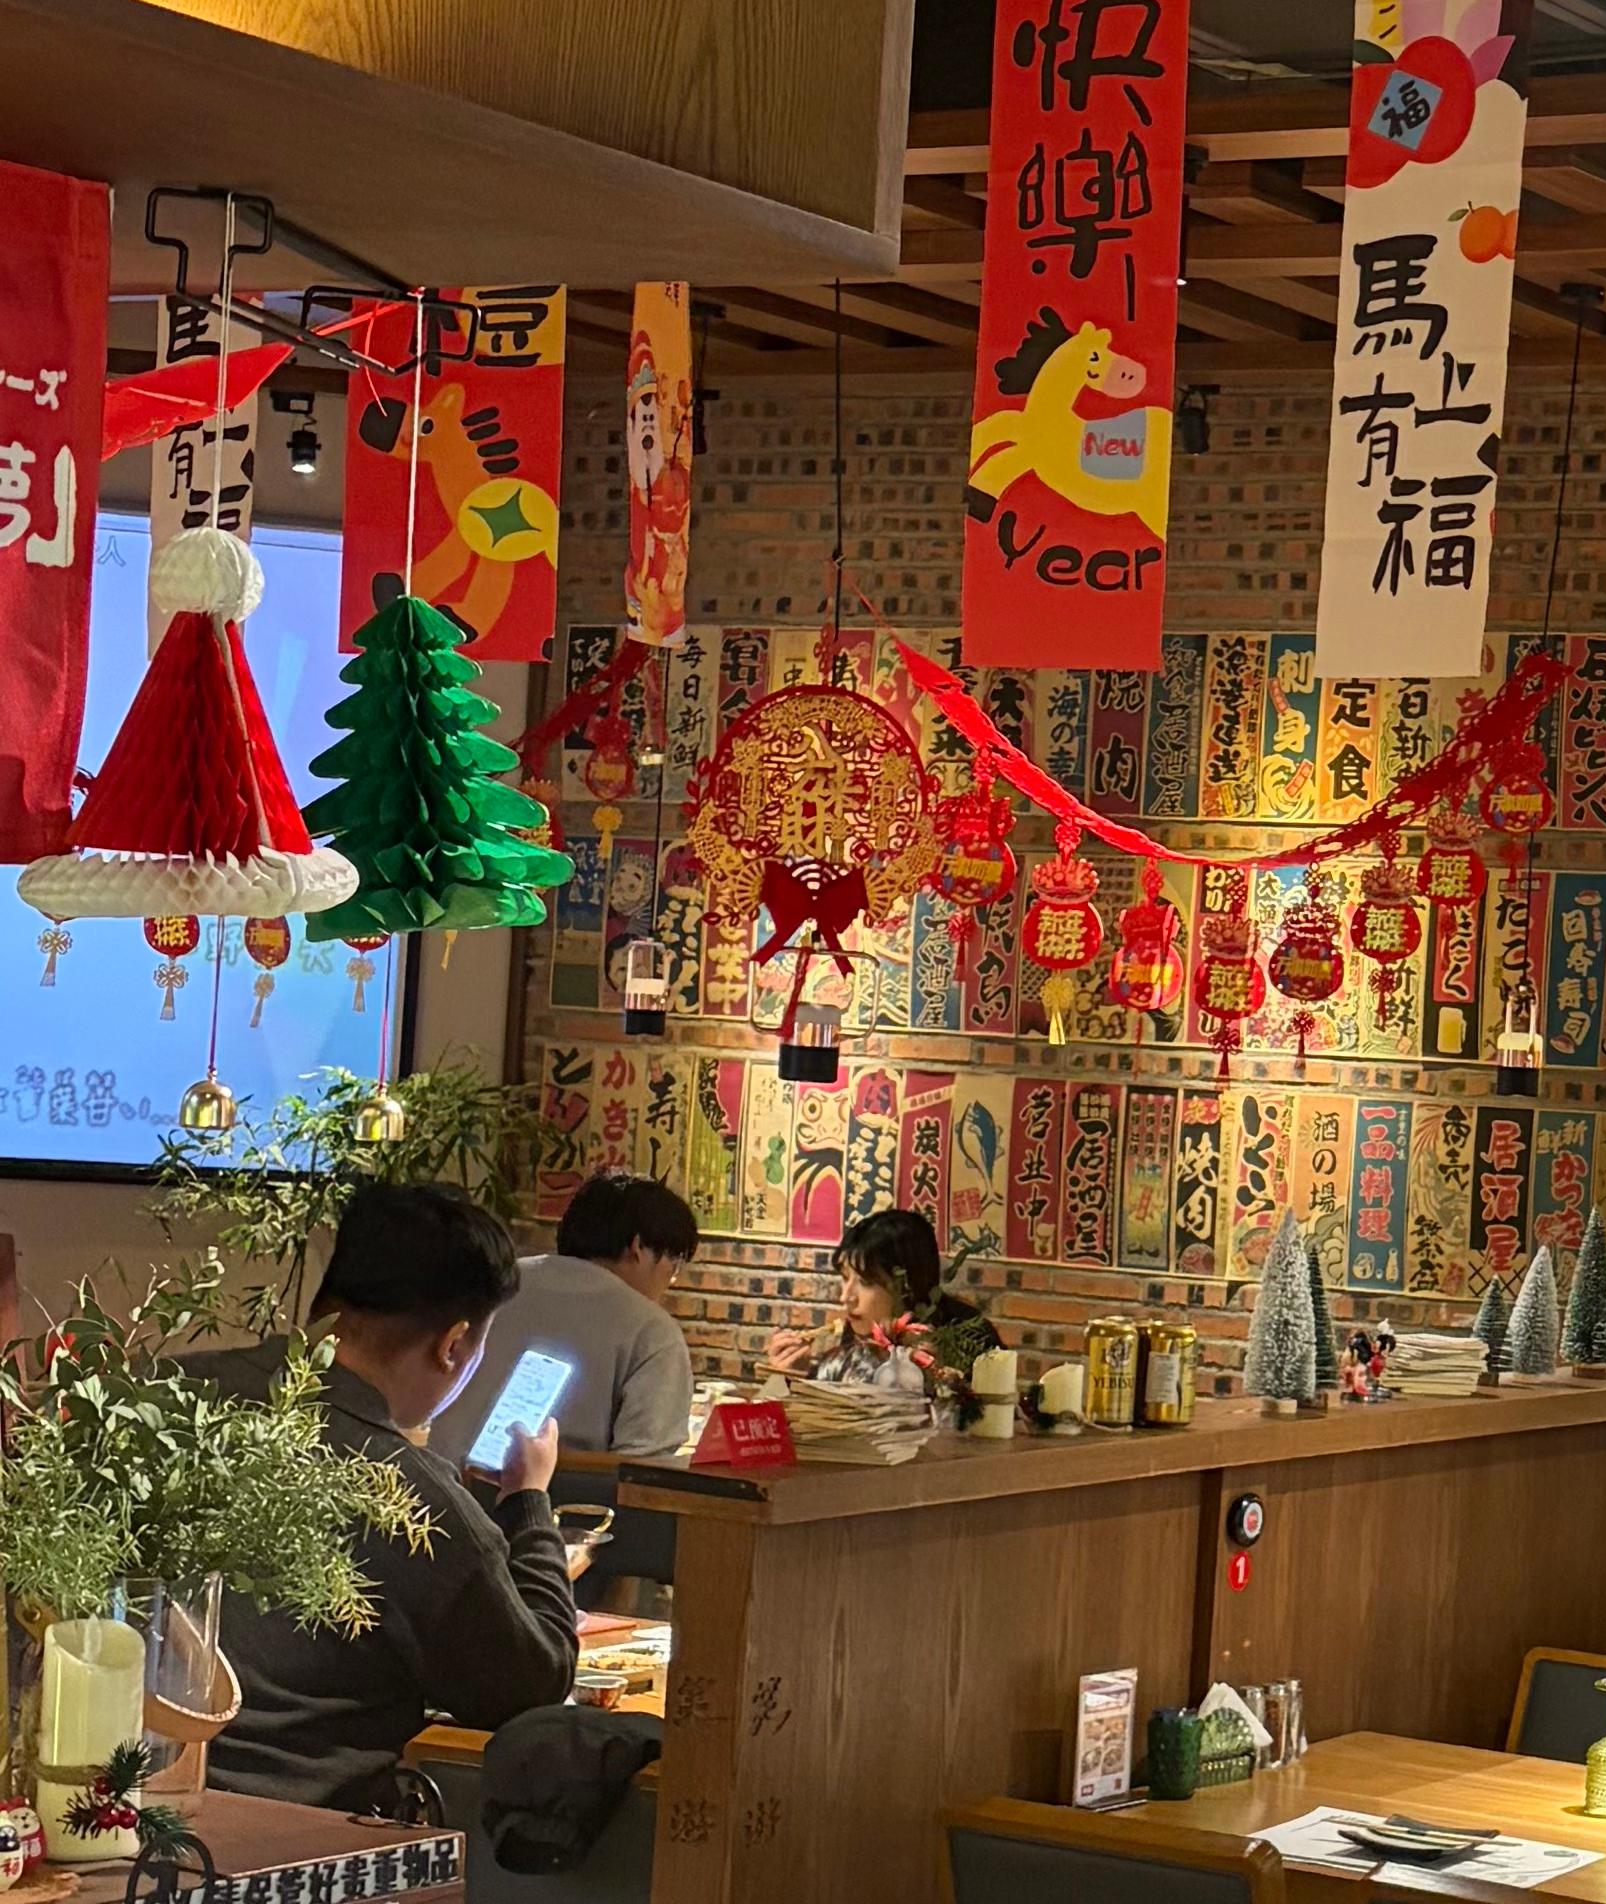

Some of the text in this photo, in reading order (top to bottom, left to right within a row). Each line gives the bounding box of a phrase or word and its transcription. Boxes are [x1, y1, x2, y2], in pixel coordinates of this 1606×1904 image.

[1380, 80, 1433, 139] 福
[1082, 430, 1145, 460] New
[1339, 234, 1494, 596] 馬上有福
[997, 511, 1162, 592] Year
[1275, 649, 1316, 753] 刺身
[1325, 678, 1377, 802] 定食
[1064, 1118, 1112, 1267] 居酒屋
[1175, 1130, 1221, 1242] 焼肉
[1308, 1110, 1340, 1214] 酒の場
[1355, 1105, 1397, 1244] 一品料理
[1479, 1119, 1527, 1273] 居酒屋
[1234, 1556, 1247, 1586] 1
